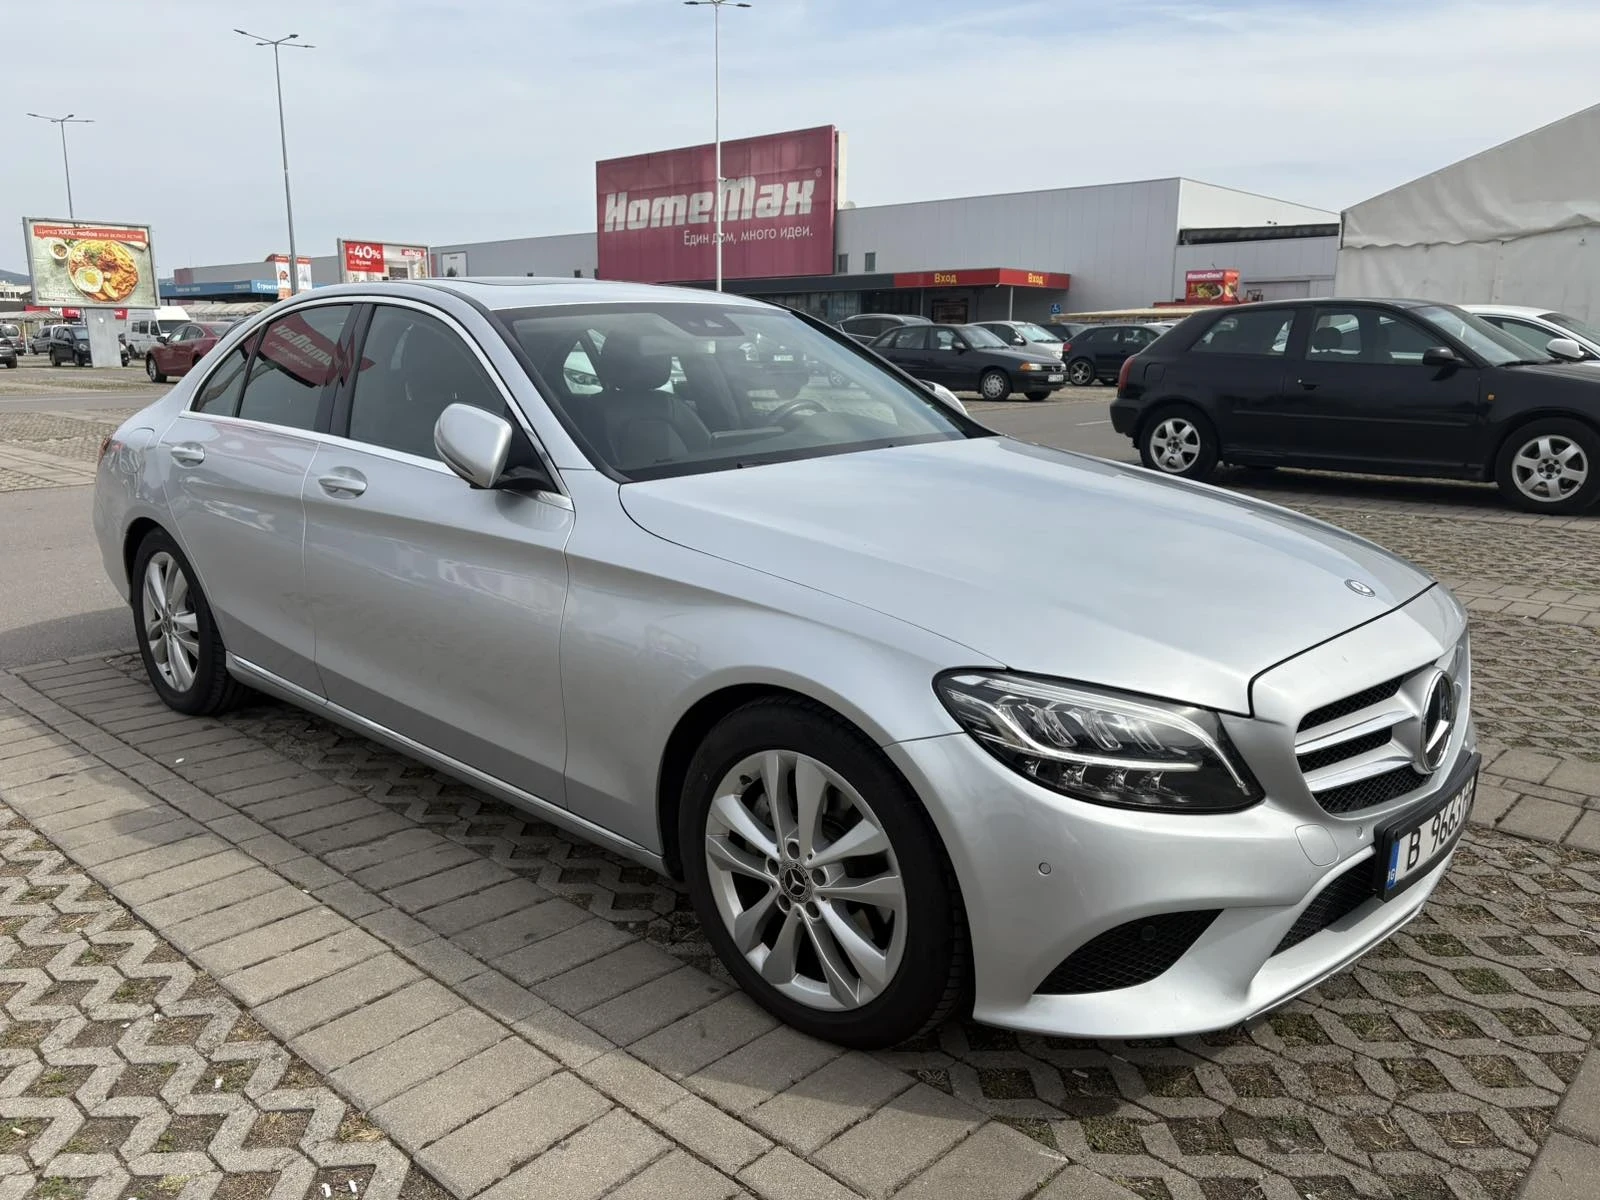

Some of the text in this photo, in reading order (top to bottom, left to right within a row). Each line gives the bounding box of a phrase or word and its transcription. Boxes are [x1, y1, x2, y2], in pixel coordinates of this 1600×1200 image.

[604, 176, 816, 233] HomeMax
[683, 229, 709, 246] Един
[741, 227, 776, 240] много
[780, 225, 813, 239] идеи.
[348, 245, 381, 259] -40%
[934, 272, 957, 284] Вход
[1027, 272, 1044, 286] Вход
[1407, 827, 1421, 871] B
